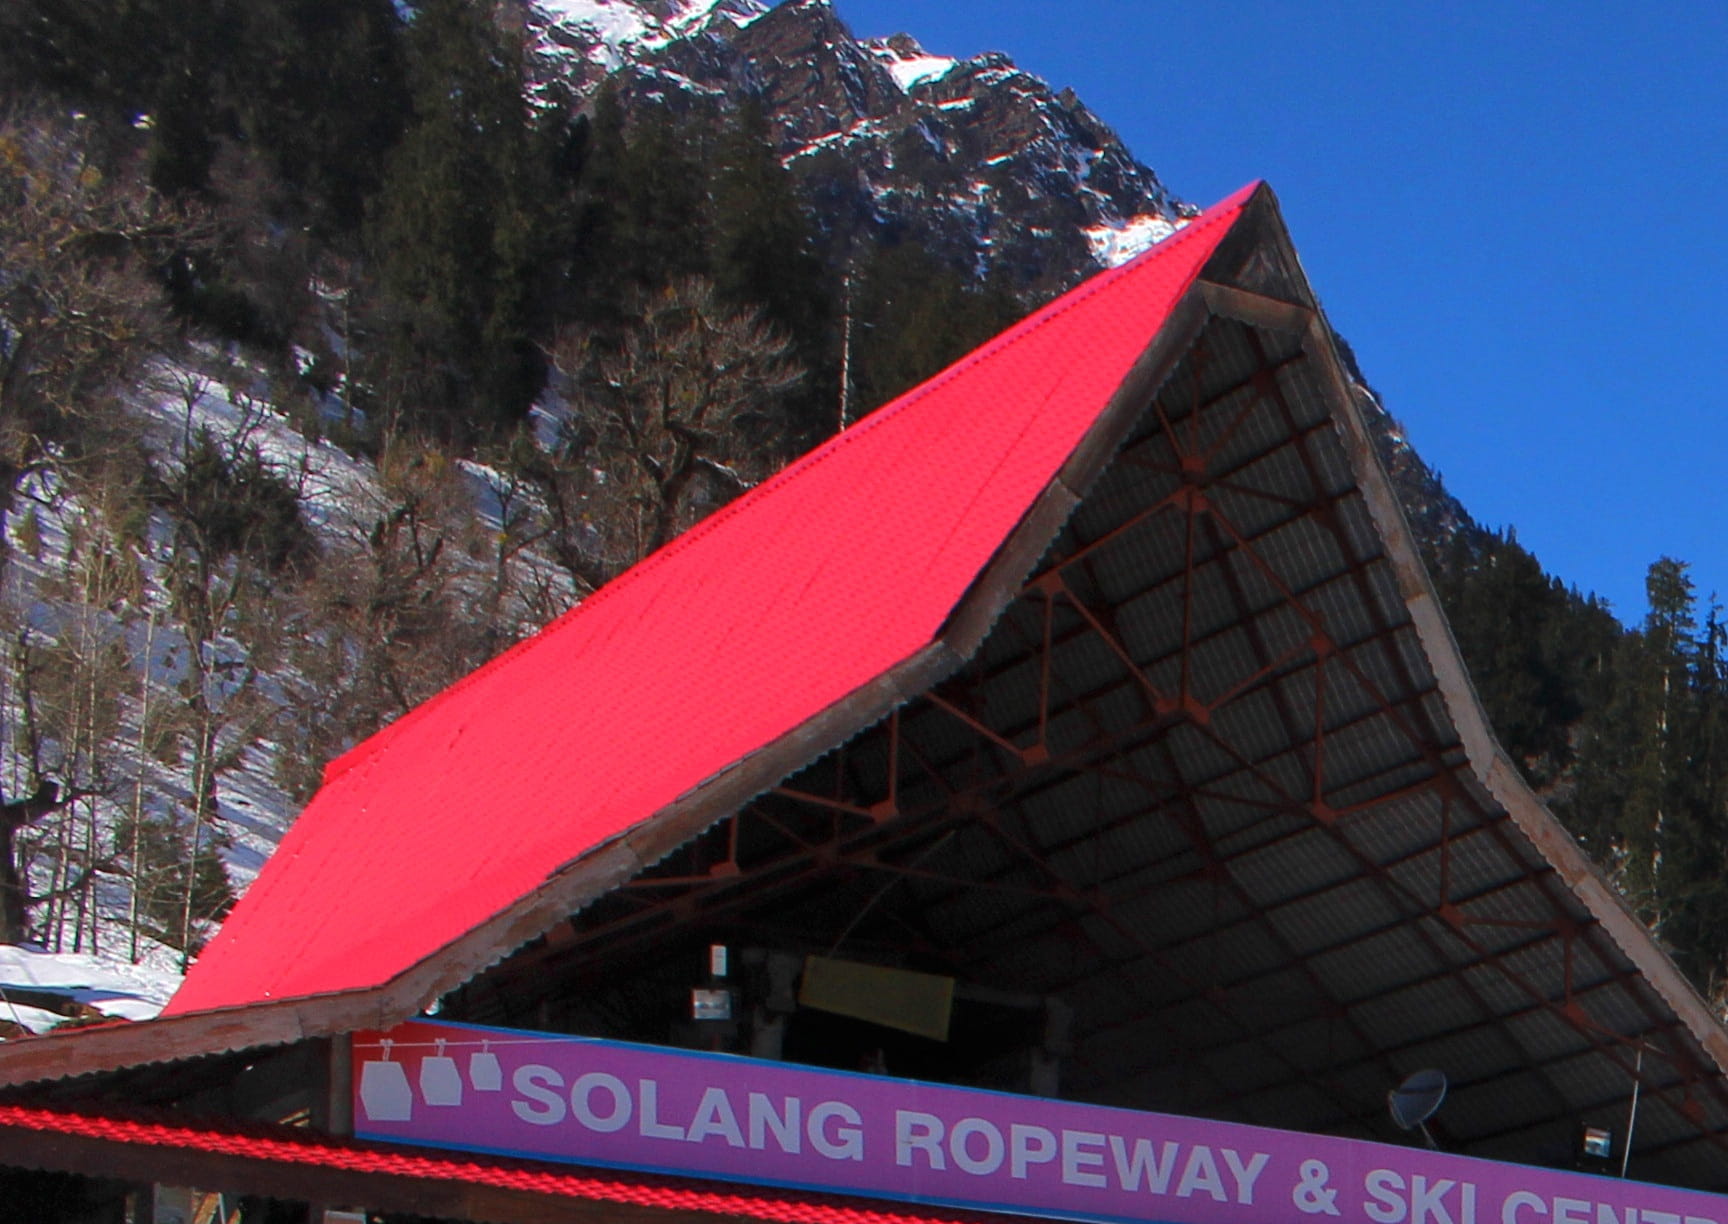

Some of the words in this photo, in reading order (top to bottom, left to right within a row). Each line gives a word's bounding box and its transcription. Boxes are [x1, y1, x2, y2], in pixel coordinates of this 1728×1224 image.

[511, 1062, 864, 1162] SOLANG
[895, 1109, 1270, 1206] ROPEWAY
[1292, 1158, 1341, 1217] &
